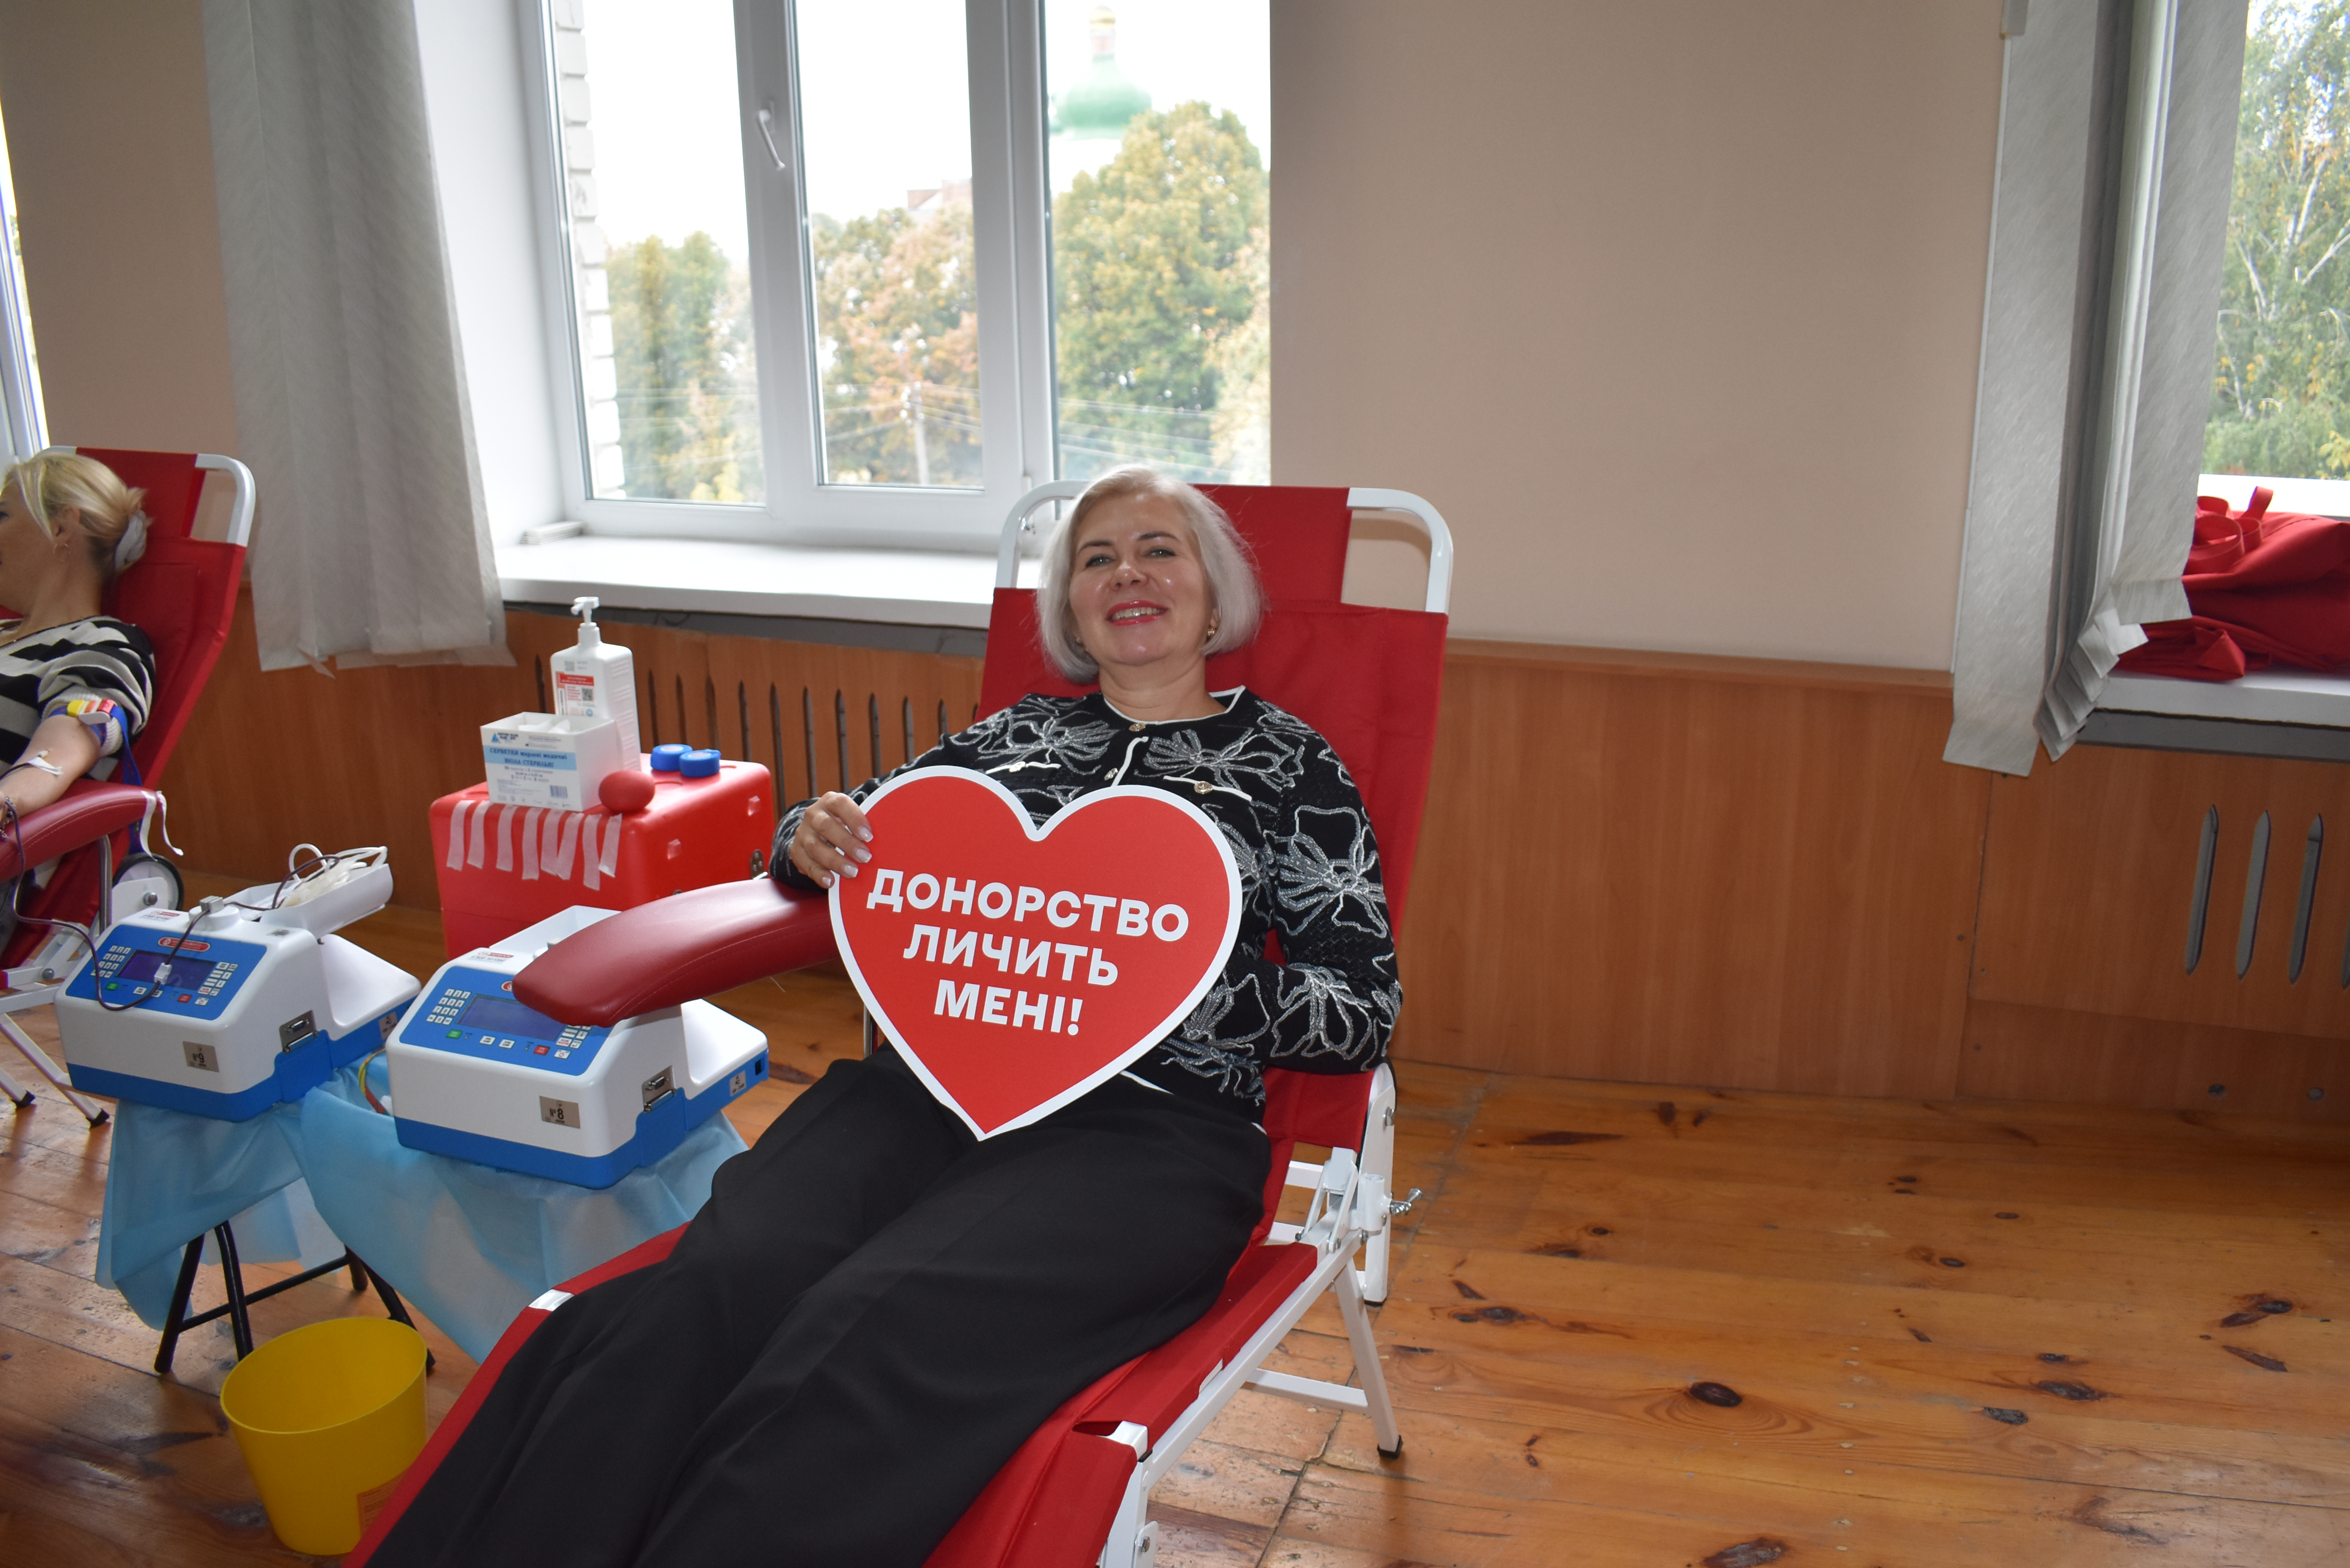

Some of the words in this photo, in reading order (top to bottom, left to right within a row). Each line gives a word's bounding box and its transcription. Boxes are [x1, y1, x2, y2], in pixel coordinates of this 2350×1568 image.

[867, 868, 1189, 942] ДОНОРСТВО
[903, 924, 1119, 986] ЛИЧИТЬ
[934, 978, 1084, 1036] МЕНІ!
